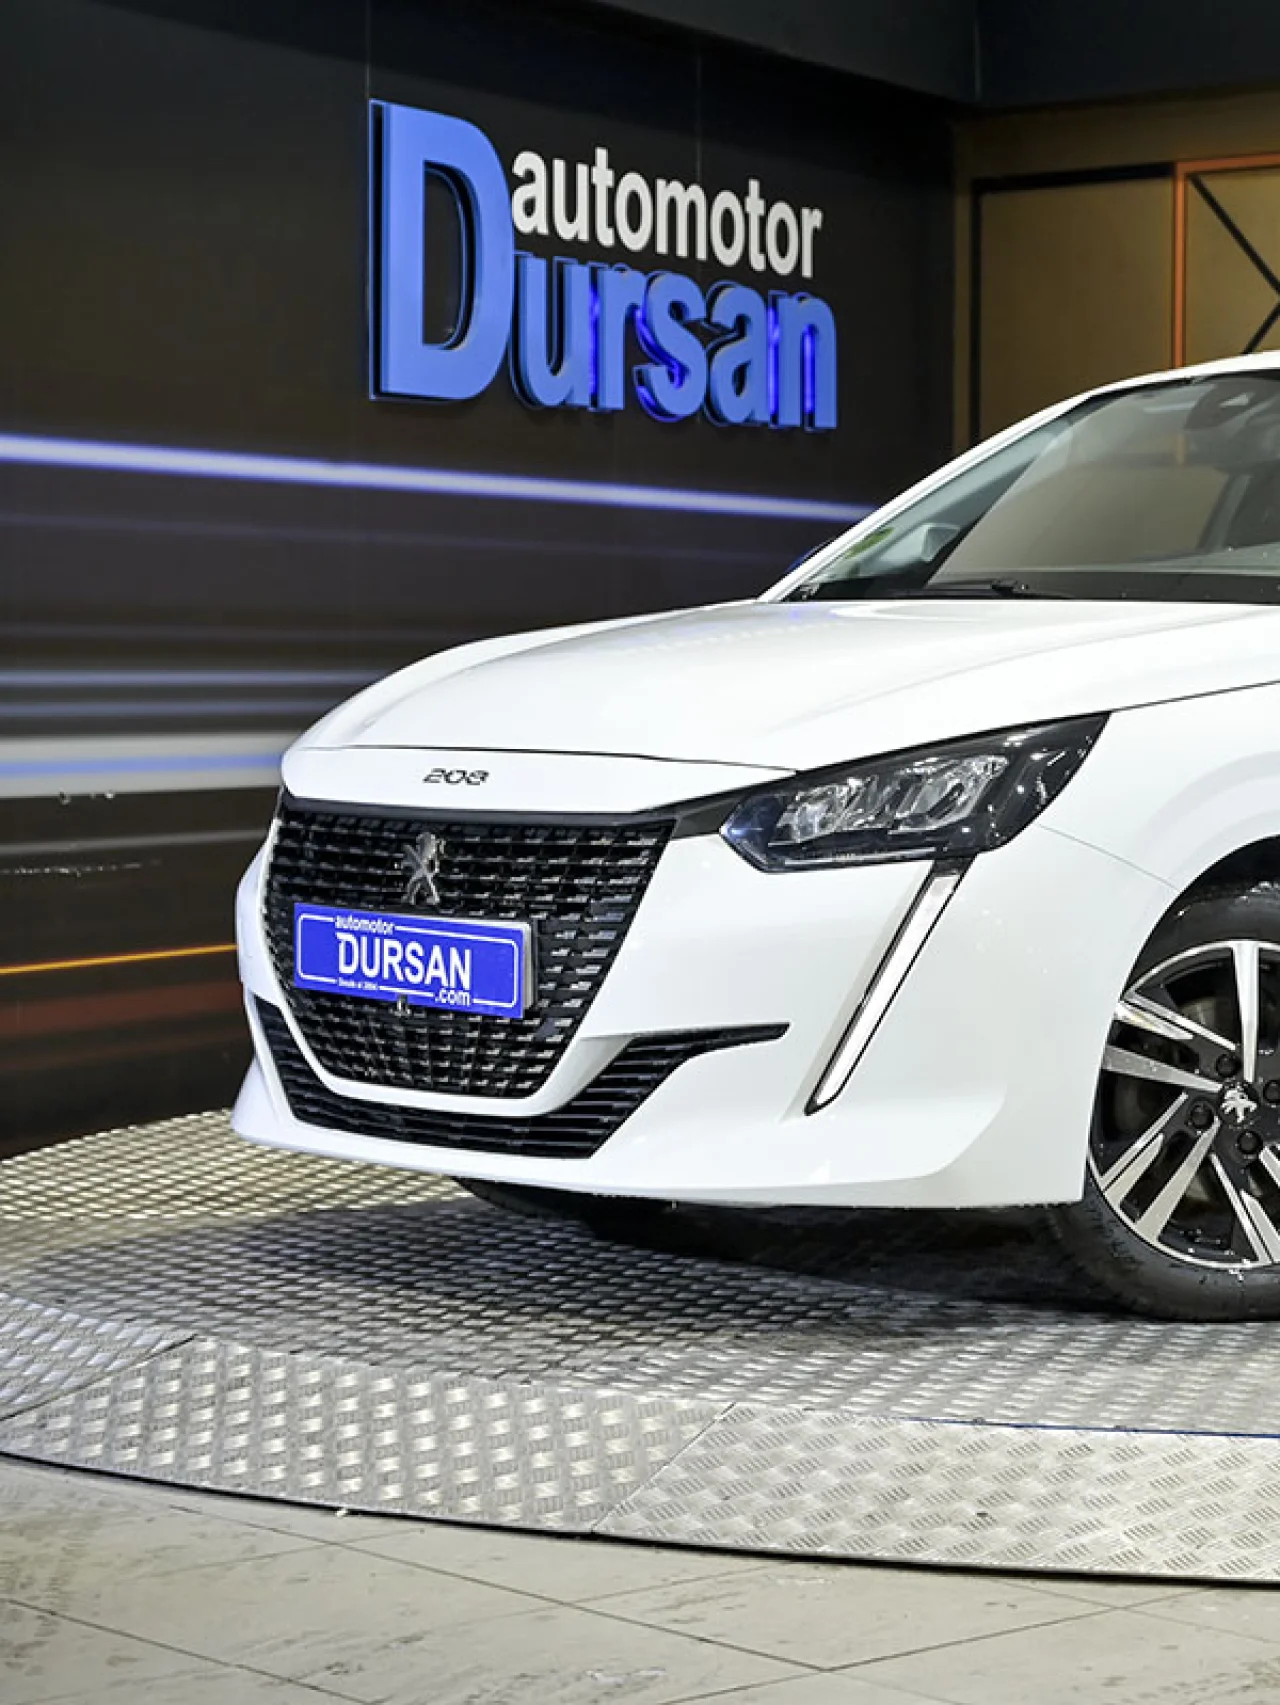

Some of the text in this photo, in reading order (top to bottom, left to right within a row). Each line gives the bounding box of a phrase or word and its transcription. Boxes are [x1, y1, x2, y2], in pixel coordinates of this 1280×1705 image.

[511, 147, 822, 278] automotor
[369, 98, 838, 431] Dursan
[422, 767, 489, 785] 208
[335, 914, 395, 935] automotor
[335, 931, 473, 990] DURSAN
[434, 987, 472, 1007] .com
